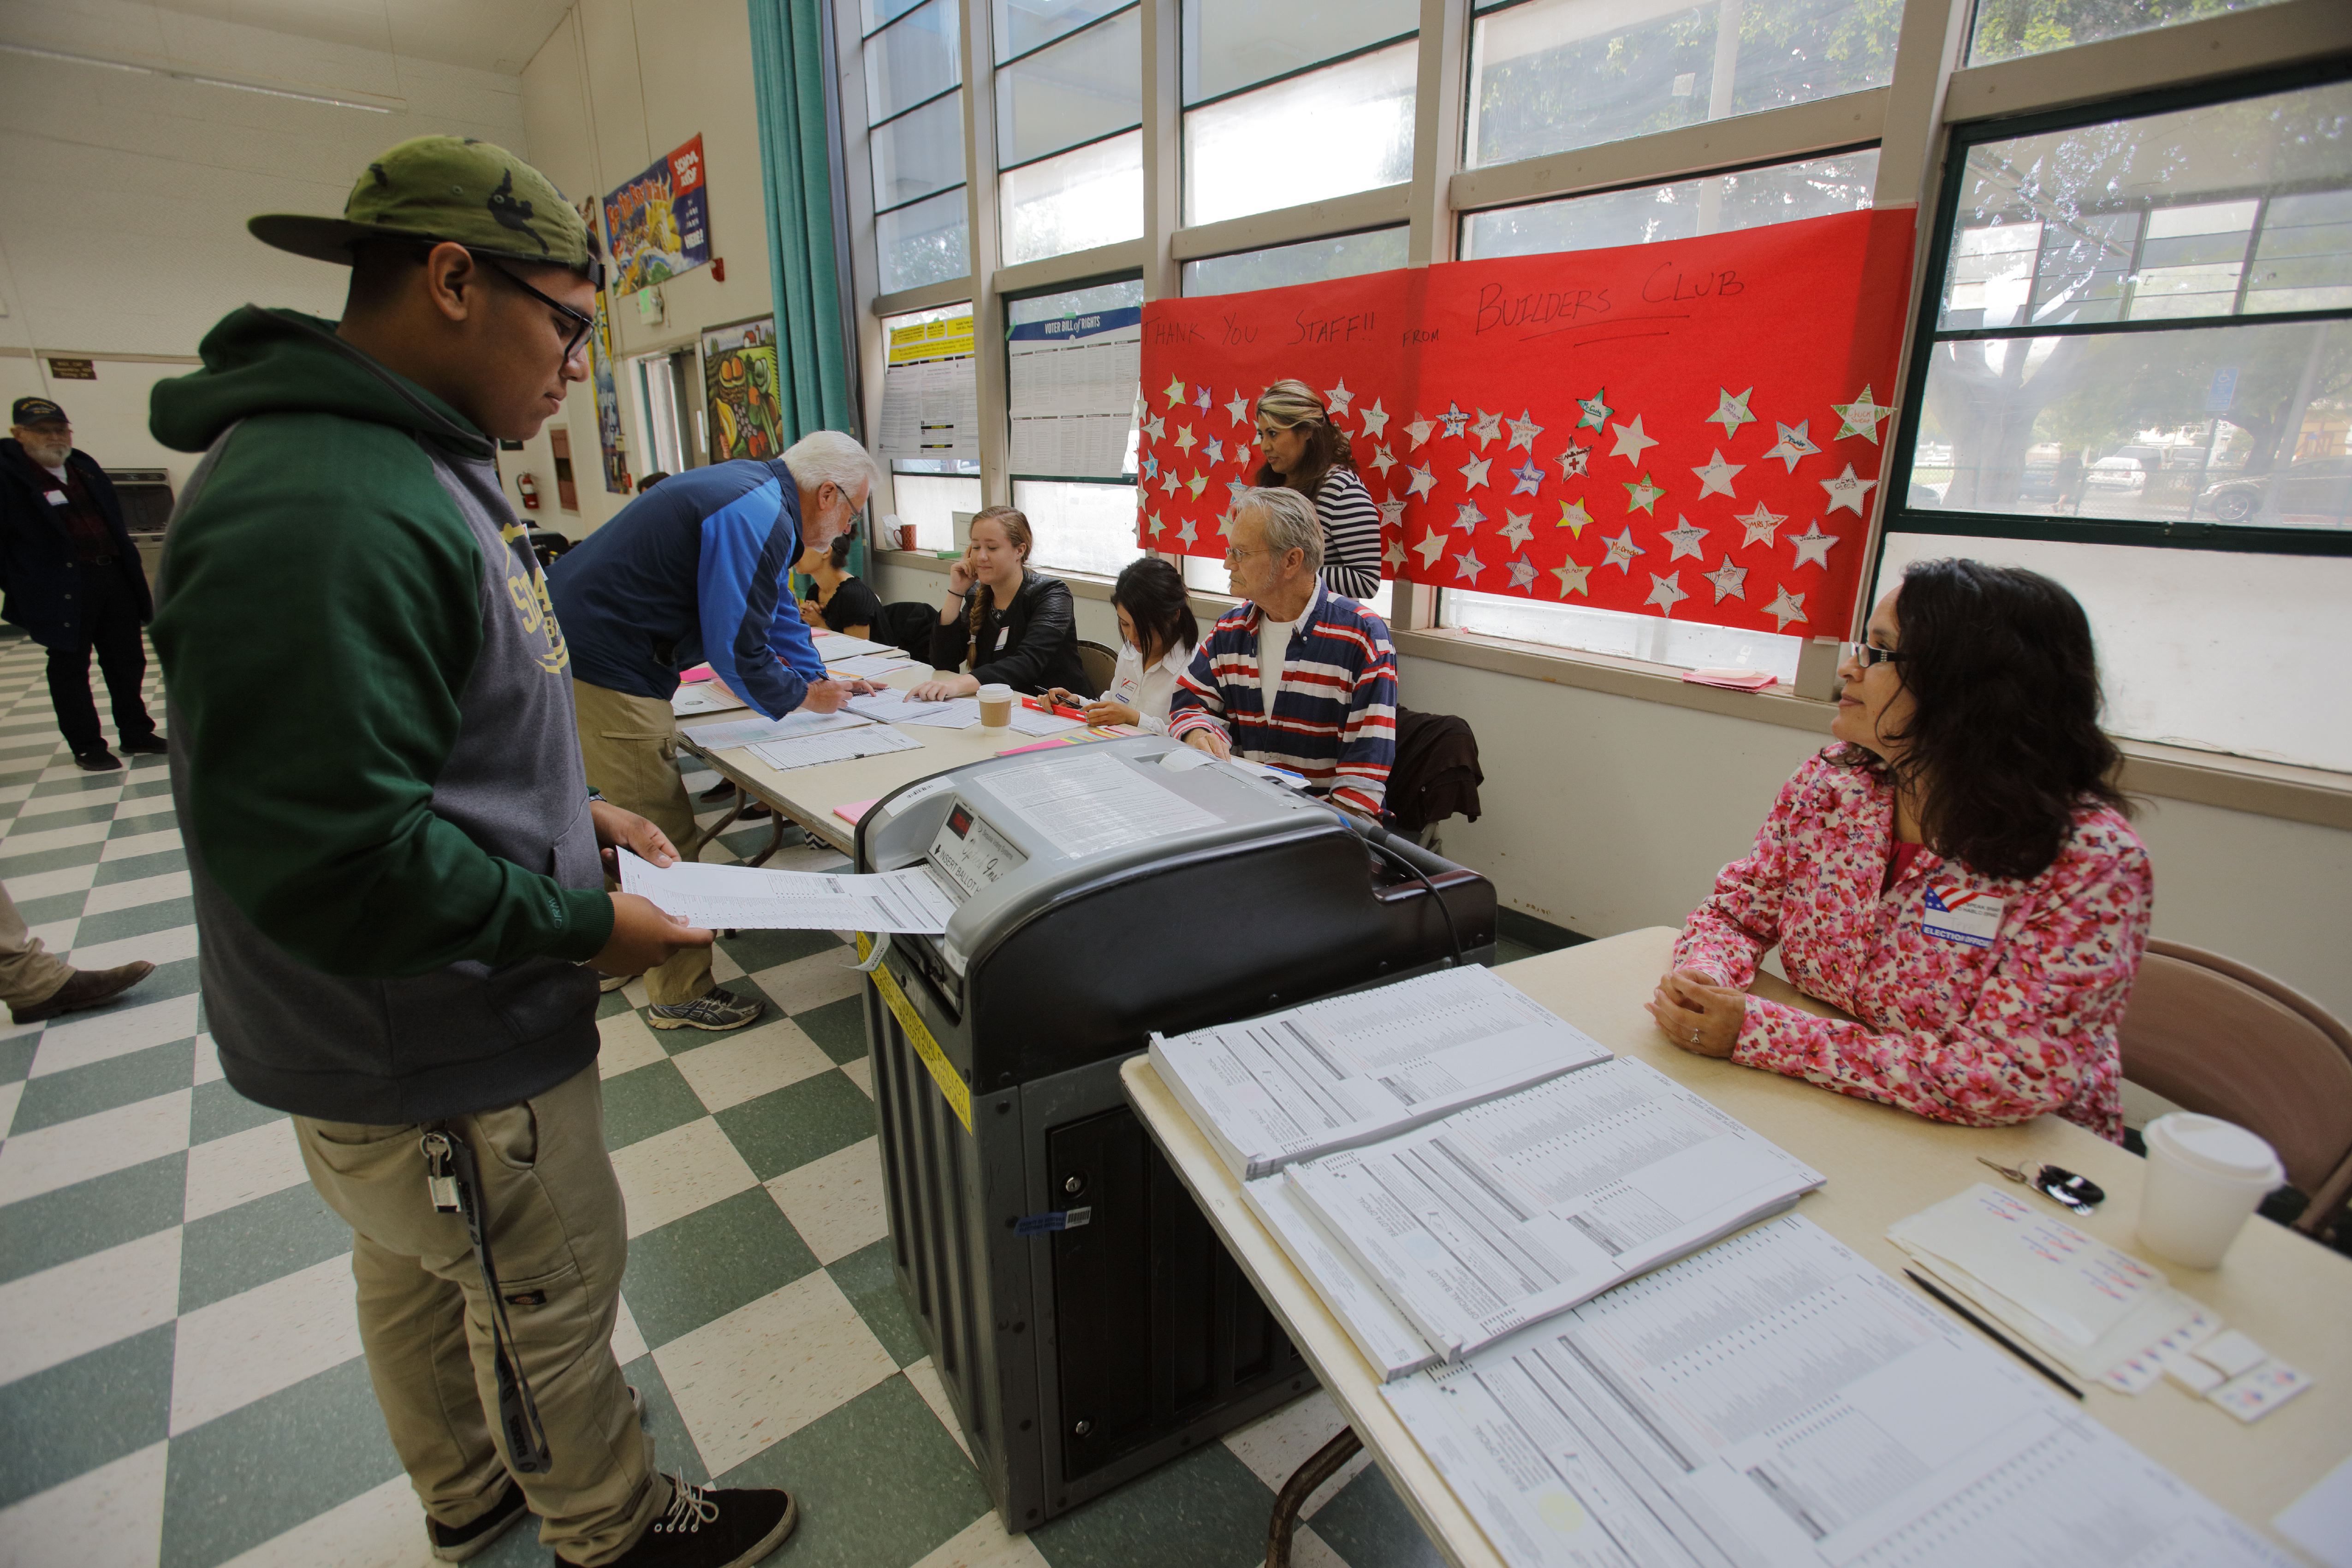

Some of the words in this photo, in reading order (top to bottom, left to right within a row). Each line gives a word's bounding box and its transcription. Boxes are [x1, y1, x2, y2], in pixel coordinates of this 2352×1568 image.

[1141, 316, 1206, 346] THANK
[1222, 312, 1259, 345] YOU
[1402, 329, 1440, 347] FROM
[1476, 283, 1610, 335] BUILDERS
[1642, 261, 1744, 303] CLUB
[1045, 322, 1061, 334] VOTER
[1062, 320, 1073, 332] BILL
[1074, 318, 1081, 333] of
[1081, 315, 1100, 329] RIGHTS
[1847, 408, 1872, 417] Chuck
[939, 851, 958, 872] INSERT
[955, 867, 977, 891] BALLOT
[1924, 927, 1965, 941] ELECTION
[937, 1051, 966, 1100] BALLOT
[1375, 1215, 1399, 1238] BALOTA
[1426, 1268, 1453, 1293] BALLOT
[1449, 1291, 1480, 1320] OFFICIAL
